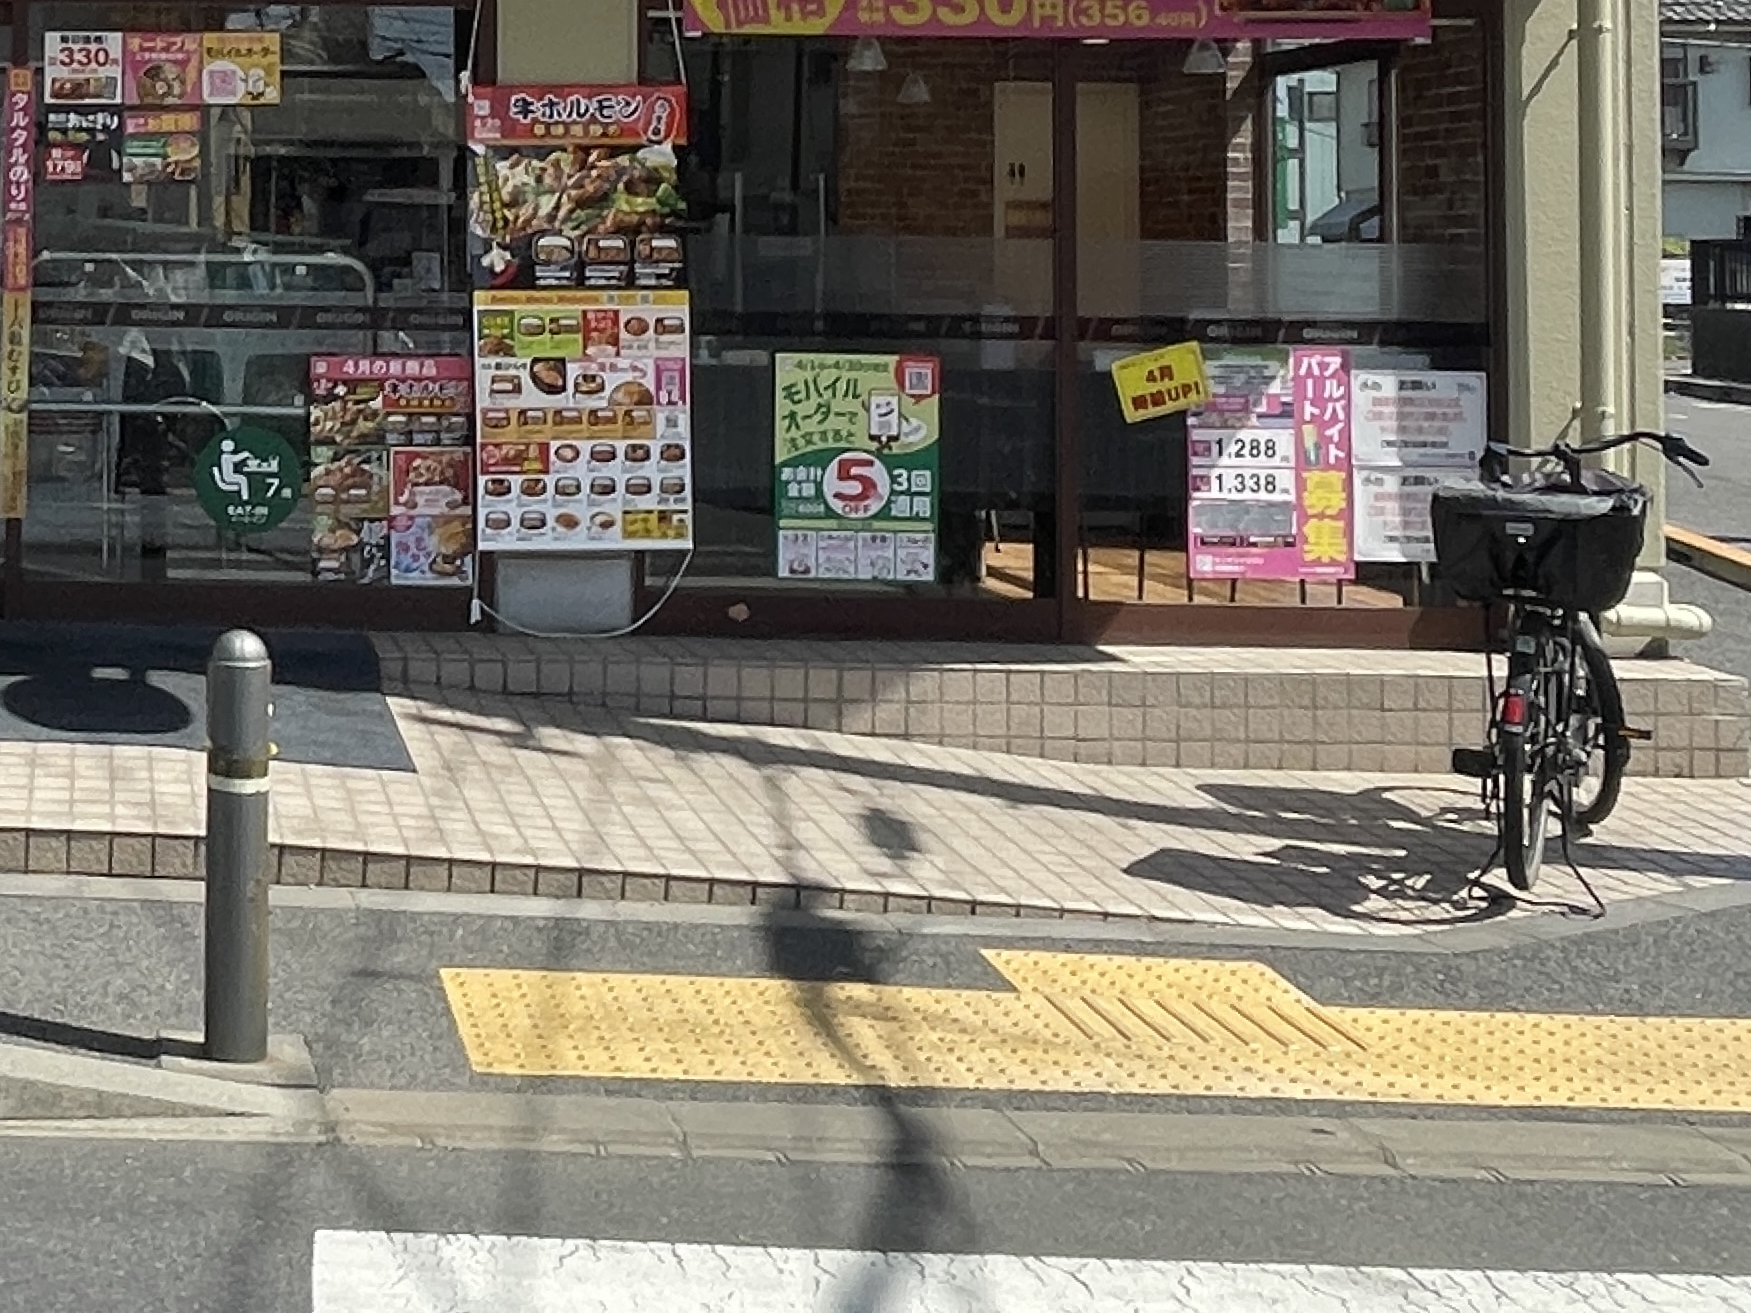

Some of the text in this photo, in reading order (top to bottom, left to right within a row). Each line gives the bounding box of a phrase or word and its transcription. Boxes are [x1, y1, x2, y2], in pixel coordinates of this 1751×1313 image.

[510, 93, 643, 122] 牛ホルモン
[782, 371, 862, 405] モバイル
[1299, 355, 1321, 421] パート
[1322, 356, 1346, 465] アルバイト
[892, 469, 931, 493] 3回
